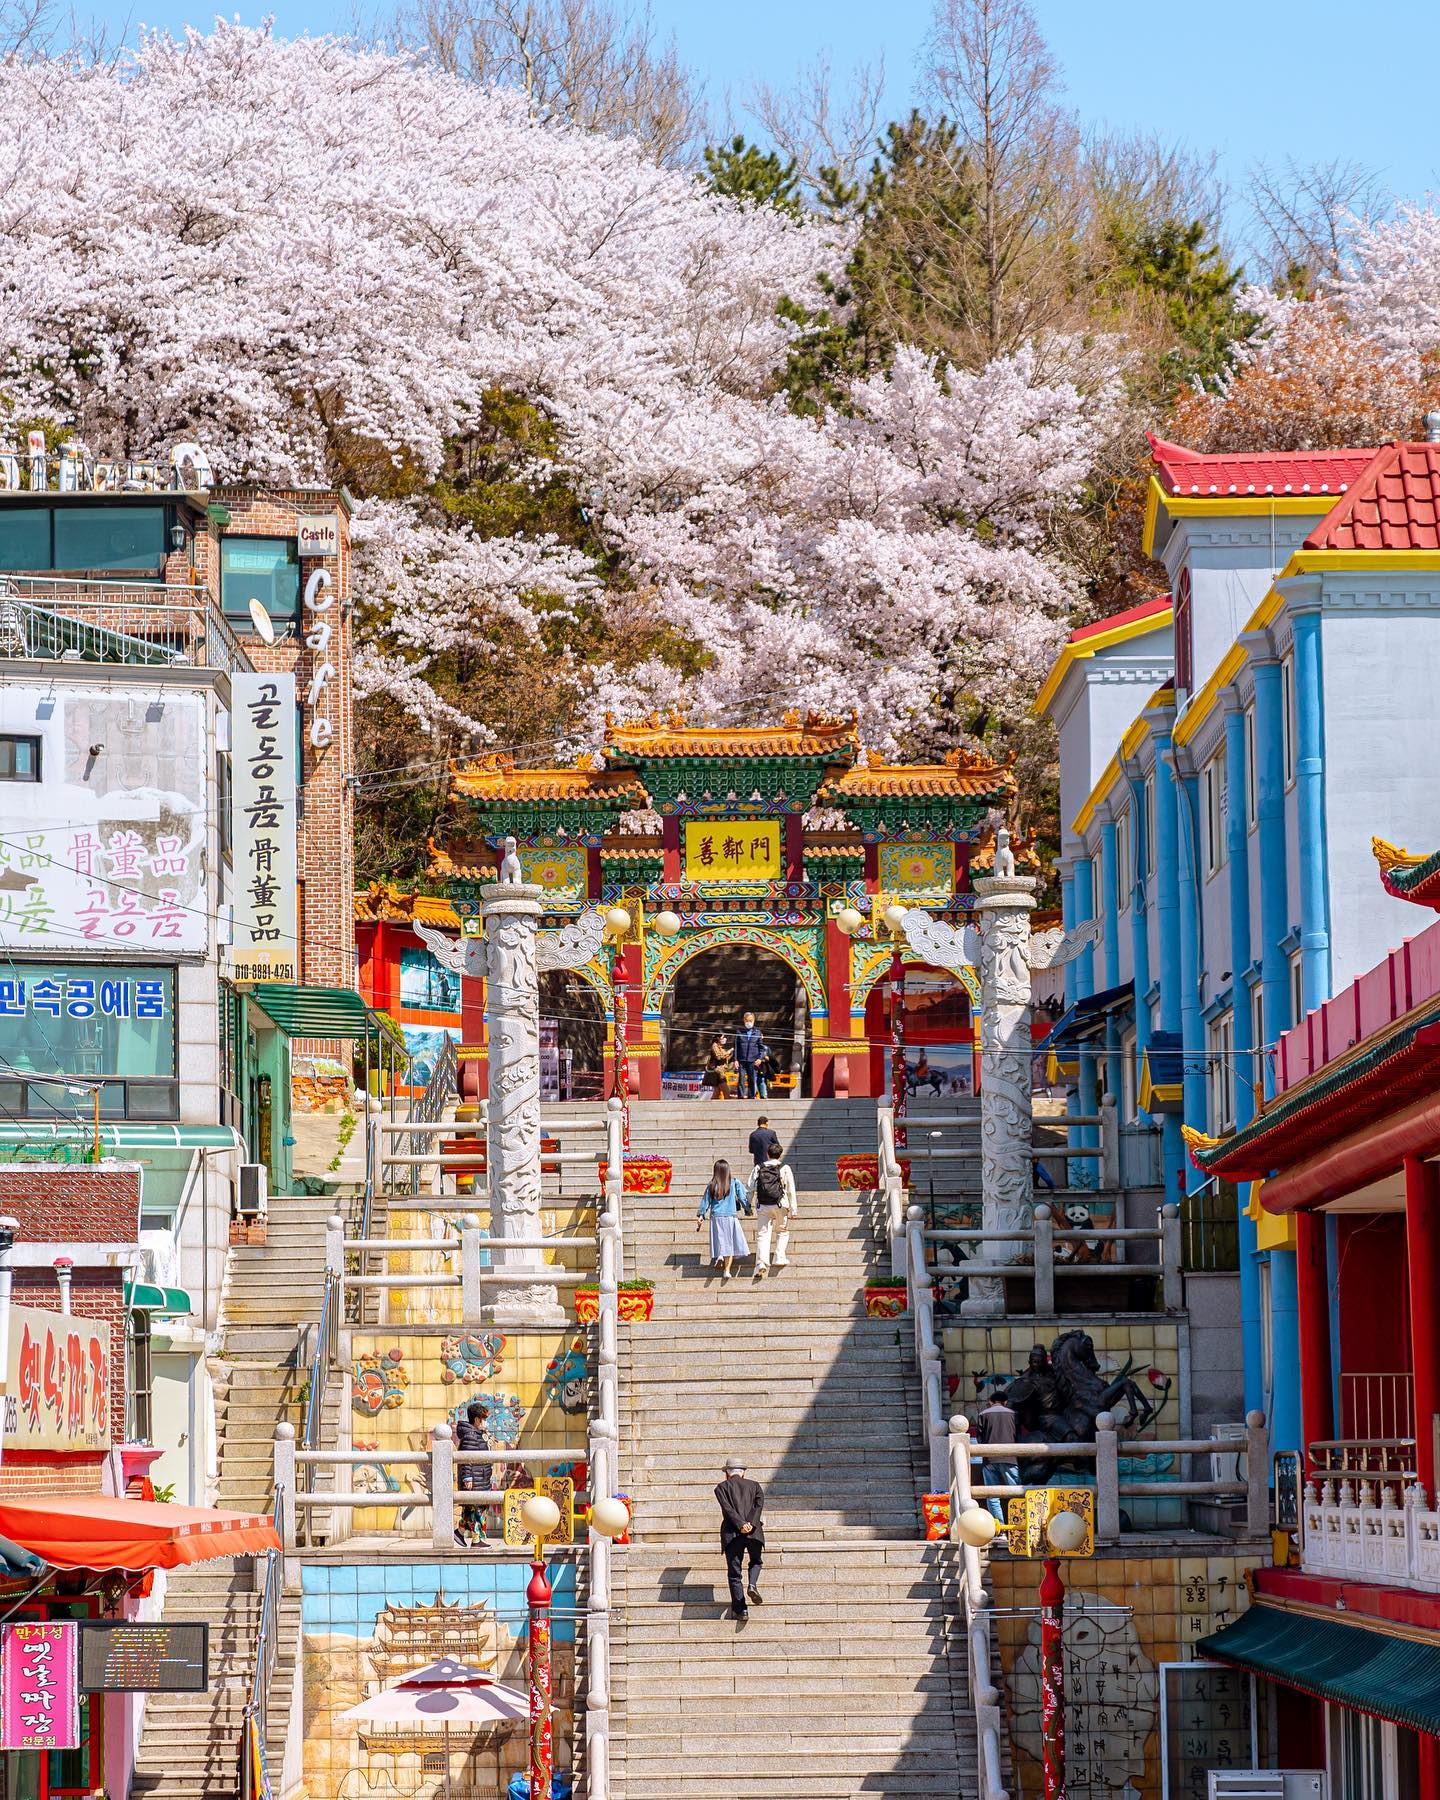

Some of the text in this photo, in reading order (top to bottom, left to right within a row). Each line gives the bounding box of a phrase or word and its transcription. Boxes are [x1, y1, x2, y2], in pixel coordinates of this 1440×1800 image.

[301, 526, 335, 541] Castle
[304, 568, 336, 748] Cafe
[243, 683, 284, 943] 골동품 骨董品
[0, 834, 52, 869] 品
[67, 832, 187, 876] 骨董品
[74, 890, 188, 939] 골동품
[0, 978, 165, 1019] 민속공예품
[15, 1626, 63, 1640] 만사성
[22, 1736, 56, 1746] 전문점
